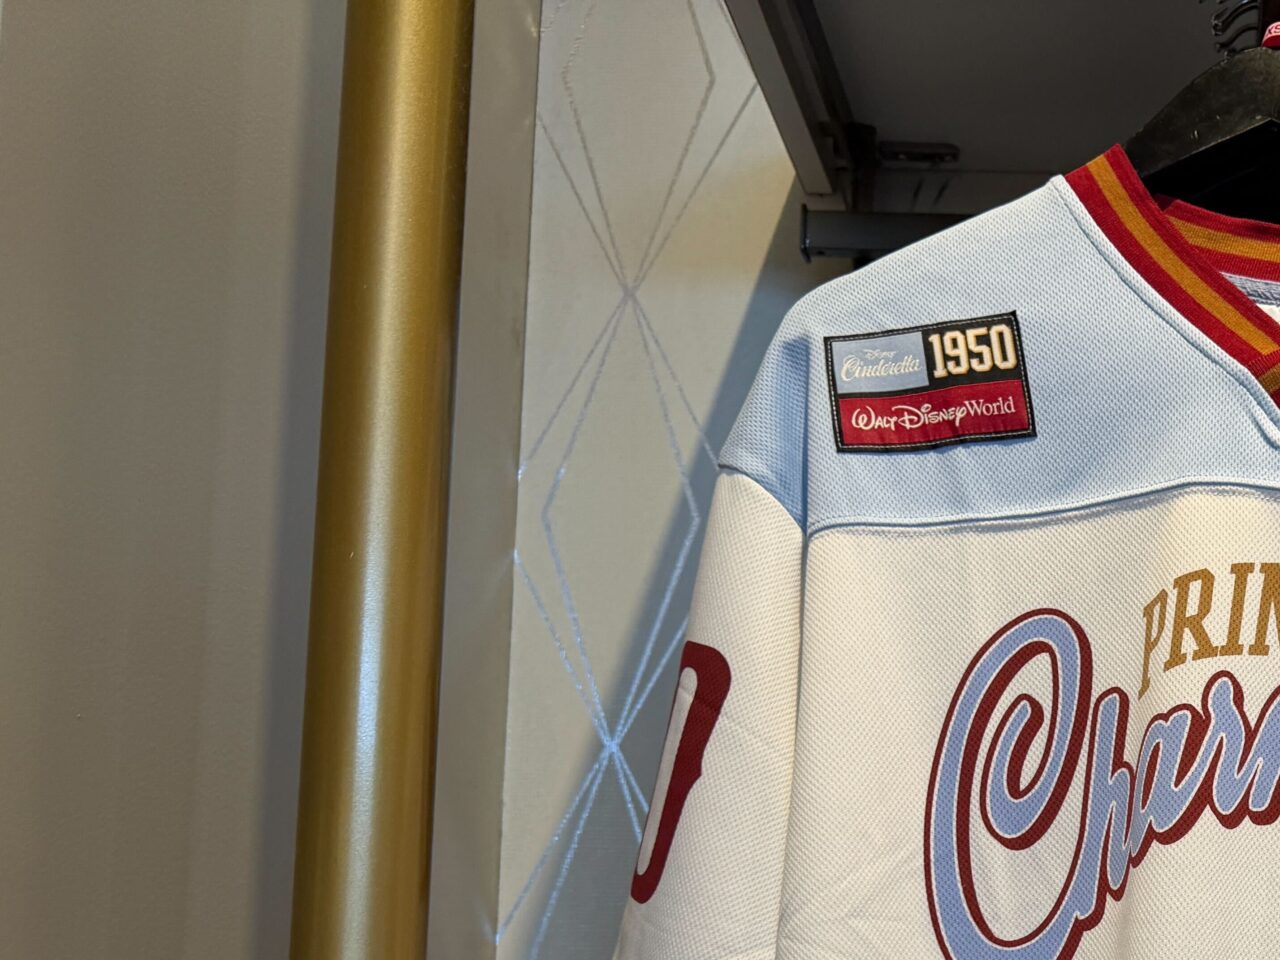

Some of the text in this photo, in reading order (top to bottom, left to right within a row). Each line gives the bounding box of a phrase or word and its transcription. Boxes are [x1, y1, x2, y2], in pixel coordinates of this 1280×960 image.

[928, 323, 1018, 379] 1950
[841, 354, 922, 382] Cinderella
[963, 396, 1016, 417] World
